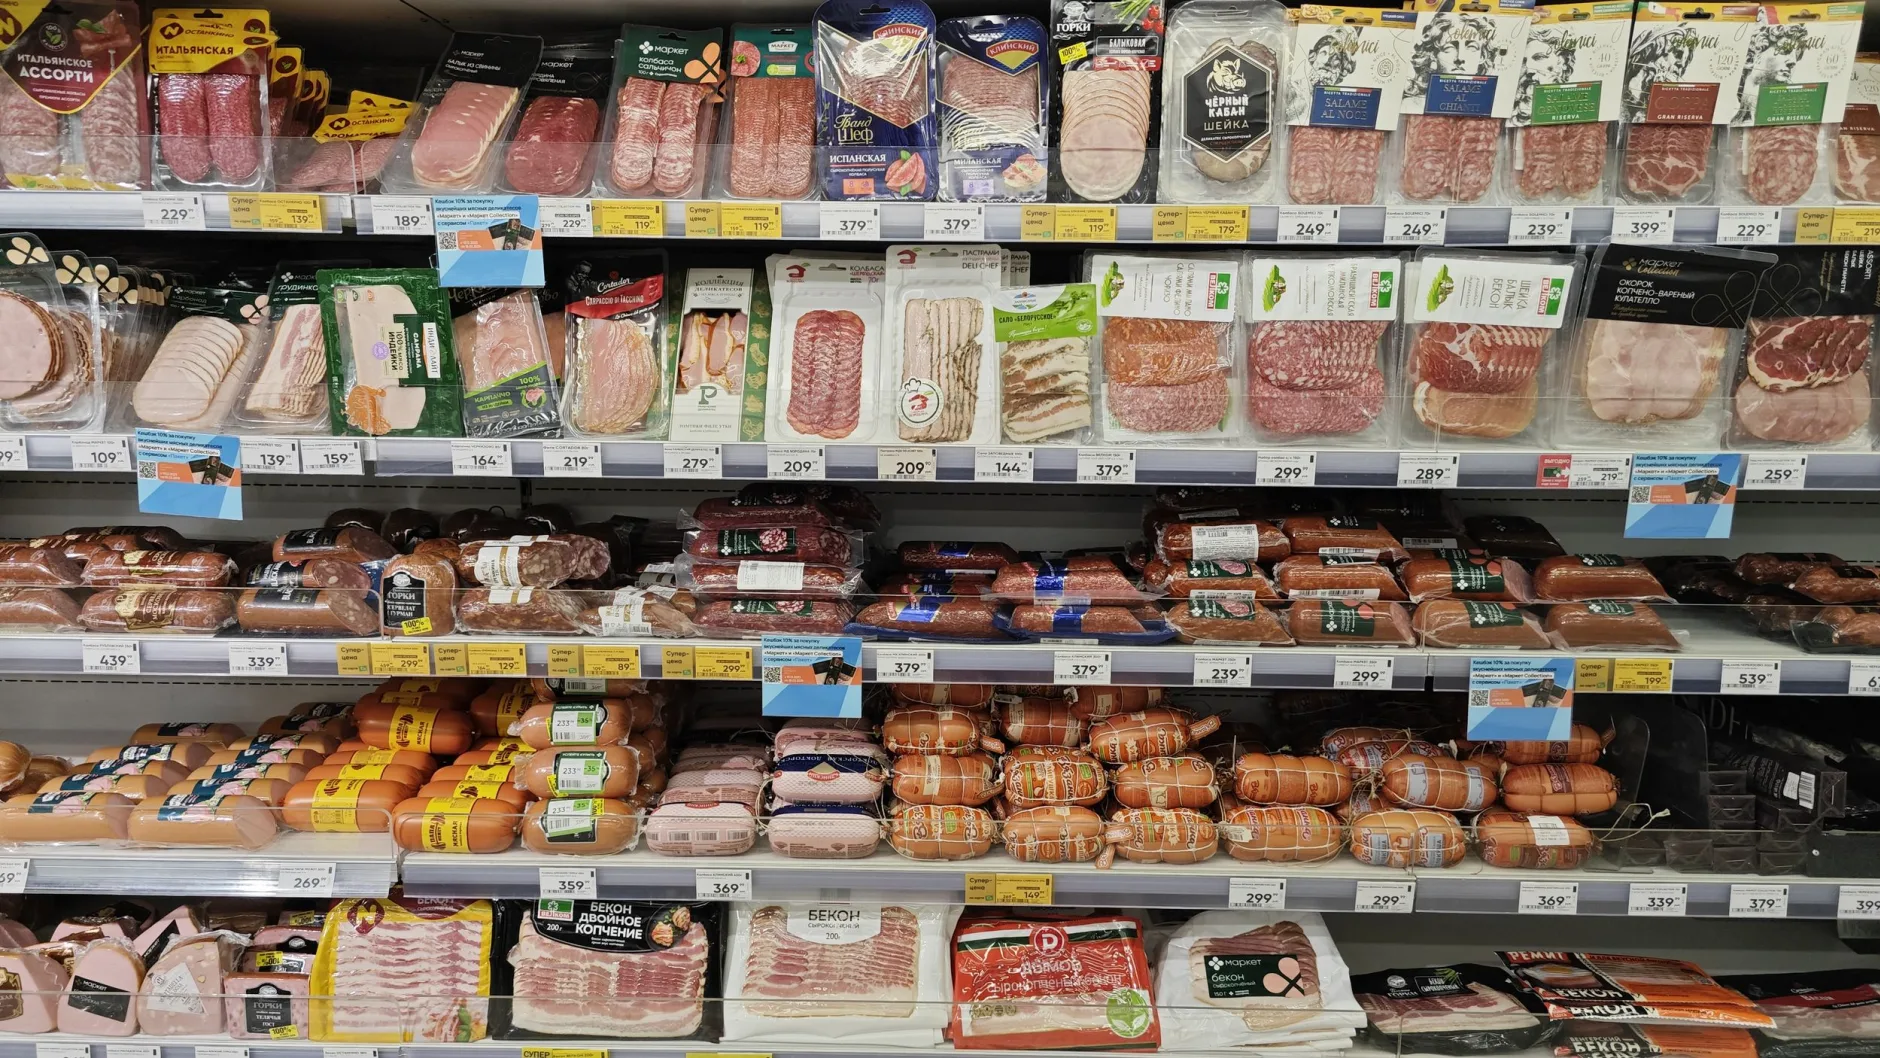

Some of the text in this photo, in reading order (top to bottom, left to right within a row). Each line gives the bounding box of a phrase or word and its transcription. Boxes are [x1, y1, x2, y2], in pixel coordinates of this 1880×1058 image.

[1056, 23, 1091, 32] ГОРКИ
[185, 30, 234, 38] ОСТАНКИНО
[1109, 38, 1146, 48] БАЛЫКОВАЯ
[156, 46, 234, 54] ИТАЛЬЯНСКАЯ
[654, 45, 688, 55] маркет
[988, 42, 1035, 55] КЛИНСКИЙ
[1061, 46, 1081, 57] 100%
[18, 54, 93, 68] ИТАЛЬЯНСКОЕ
[541, 60, 574, 68] маркет
[639, 57, 674, 65] колбаса
[638, 63, 682, 73] сальчичон
[20, 66, 94, 83] АССОРТИ
[1443, 84, 1481, 94] SALAME
[1205, 94, 1249, 108] ЧЁРНЫЙ
[1454, 94, 1466, 102] AL
[1546, 93, 1588, 103] SALAME
[1325, 98, 1367, 109] SALAME
[1440, 102, 1480, 111] CHIANTI
[1208, 106, 1245, 118] КАБАН
[1321, 110, 1367, 120] AL NOCE
[352, 116, 395, 126] ОСТАНКИНО
[1204, 119, 1249, 131] ШЕЙКА
[838, 128, 874, 144] Шеф
[830, 154, 886, 163] ИСПАНСКАЯ
[161, 208, 188, 221] 229
[291, 215, 308, 224] 139
[394, 215, 419, 226] 189
[563, 220, 580, 228] 229
[635, 221, 650, 229] 119
[944, 219, 970, 230] 379
[754, 221, 769, 231] 119
[840, 221, 866, 231] 379
[1088, 225, 1102, 233] 119
[1296, 224, 1325, 236] 249
[1402, 224, 1431, 236] 249
[1528, 225, 1555, 235] 239
[1631, 223, 1659, 233] 399
[1737, 225, 1765, 236] 229
[1863, 228, 1880, 236] 219
[1639, 258, 1684, 269] маркет
[1864, 250, 1873, 280] ASSORTI
[1638, 266, 1680, 277] Collection
[598, 277, 634, 293] Cortador
[695, 279, 744, 287] КОЛЛЕКЦИЯ
[1619, 279, 1653, 288] ОКОРОК
[1490, 278, 1503, 309] БЕКОН
[1503, 279, 1517, 309] БАЛЫК
[1616, 287, 1695, 299] КОПЧЕНО-ВАРЕНЫЙ
[585, 296, 613, 306] CARPACCIO
[620, 294, 644, 303] TACCHINO
[1614, 295, 1660, 305] КУПАТЕЛЛО
[1014, 314, 1056, 322] «БЕЛОРУССКОЕ»
[388, 332, 398, 371] ИНДЕЙКИ
[412, 333, 422, 369] CAMPANA
[519, 376, 540, 384] 100%
[474, 392, 511, 403] КАРПАЧЧО
[91, 452, 116, 464] 109
[260, 455, 284, 465] 139
[324, 453, 347, 464] 159
[472, 455, 496, 465] 164
[564, 457, 587, 467] 219
[682, 458, 708, 469] 279
[784, 461, 811, 472] 209
[896, 463, 924, 474] 209
[995, 462, 1021, 473] 144
[1096, 465, 1122, 475] 379
[1274, 468, 1301, 478] 299
[1416, 469, 1444, 480] 289
[1765, 470, 1791, 480] 259
[388, 591, 416, 600] ГОРКИ
[404, 620, 424, 628] 100%
[100, 655, 126, 666] 439
[248, 657, 274, 667] 339
[401, 660, 417, 668] 299
[618, 663, 629, 671] 89
[895, 663, 919, 673] 379
[1072, 665, 1096, 675] 379
[1212, 669, 1237, 679] 239
[1352, 671, 1378, 682] 299
[1740, 673, 1766, 684] 539
[563, 767, 577, 775] 233
[552, 806, 566, 814] 233
[294, 878, 320, 888] 269
[558, 880, 584, 891] 359
[713, 883, 739, 894] 369
[1246, 893, 1272, 904] 299
[1374, 895, 1399, 906] 299
[1538, 896, 1564, 906] 369
[1647, 897, 1674, 907] 339
[1750, 898, 1775, 909] 379
[590, 902, 632, 914] БЕКОН
[579, 914, 641, 927] ДВОЙНОЕ
[808, 910, 860, 921] БЕКОН
[575, 926, 643, 940] КОПЧЕНИЕ
[1510, 951, 1564, 961] РЕМИТ
[1225, 960, 1261, 968] маркет
[1211, 973, 1244, 981] бекон
[272, 1027, 292, 1036] 100%
[1574, 1041, 1641, 1054] БЕКОН
[523, 1050, 550, 1058] СУПЕР
